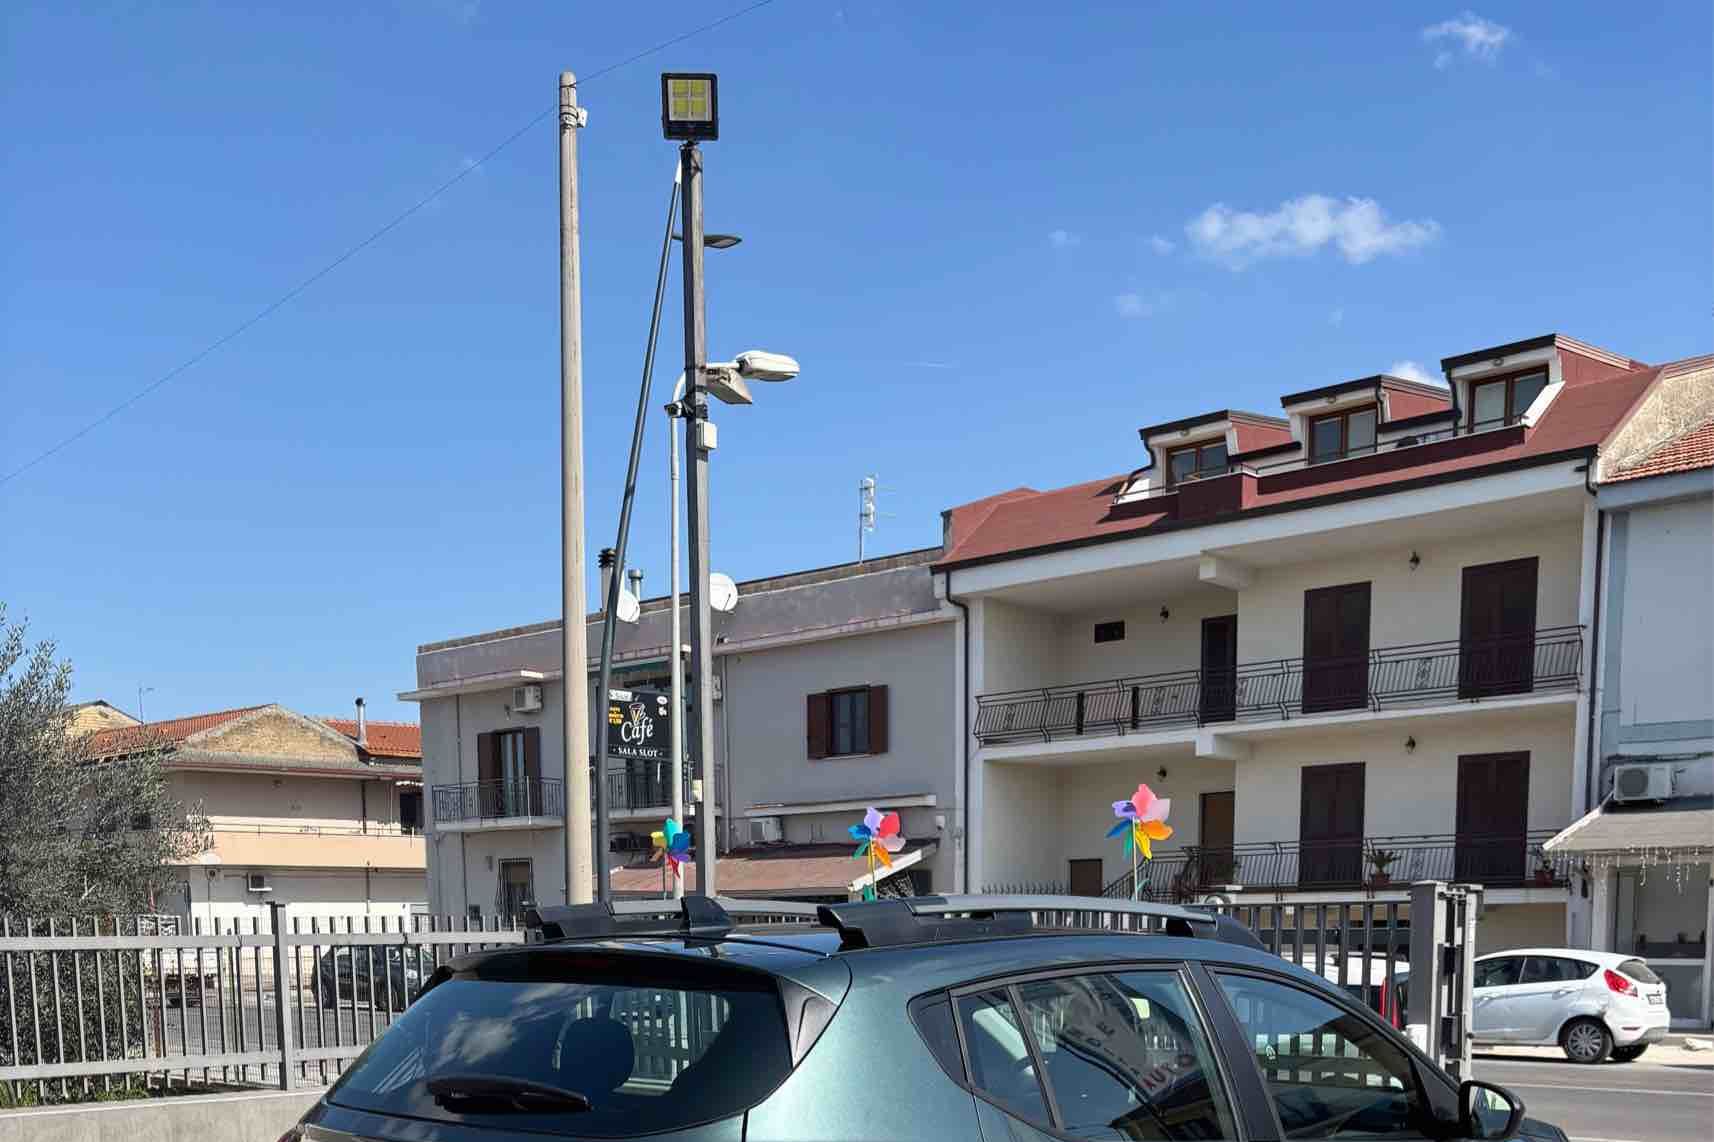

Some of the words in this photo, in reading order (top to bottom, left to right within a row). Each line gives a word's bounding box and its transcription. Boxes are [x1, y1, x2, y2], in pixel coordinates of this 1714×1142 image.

[621, 716, 653, 745] Café
[618, 746, 637, 755] SALA
[640, 748, 658, 757] SLOT
